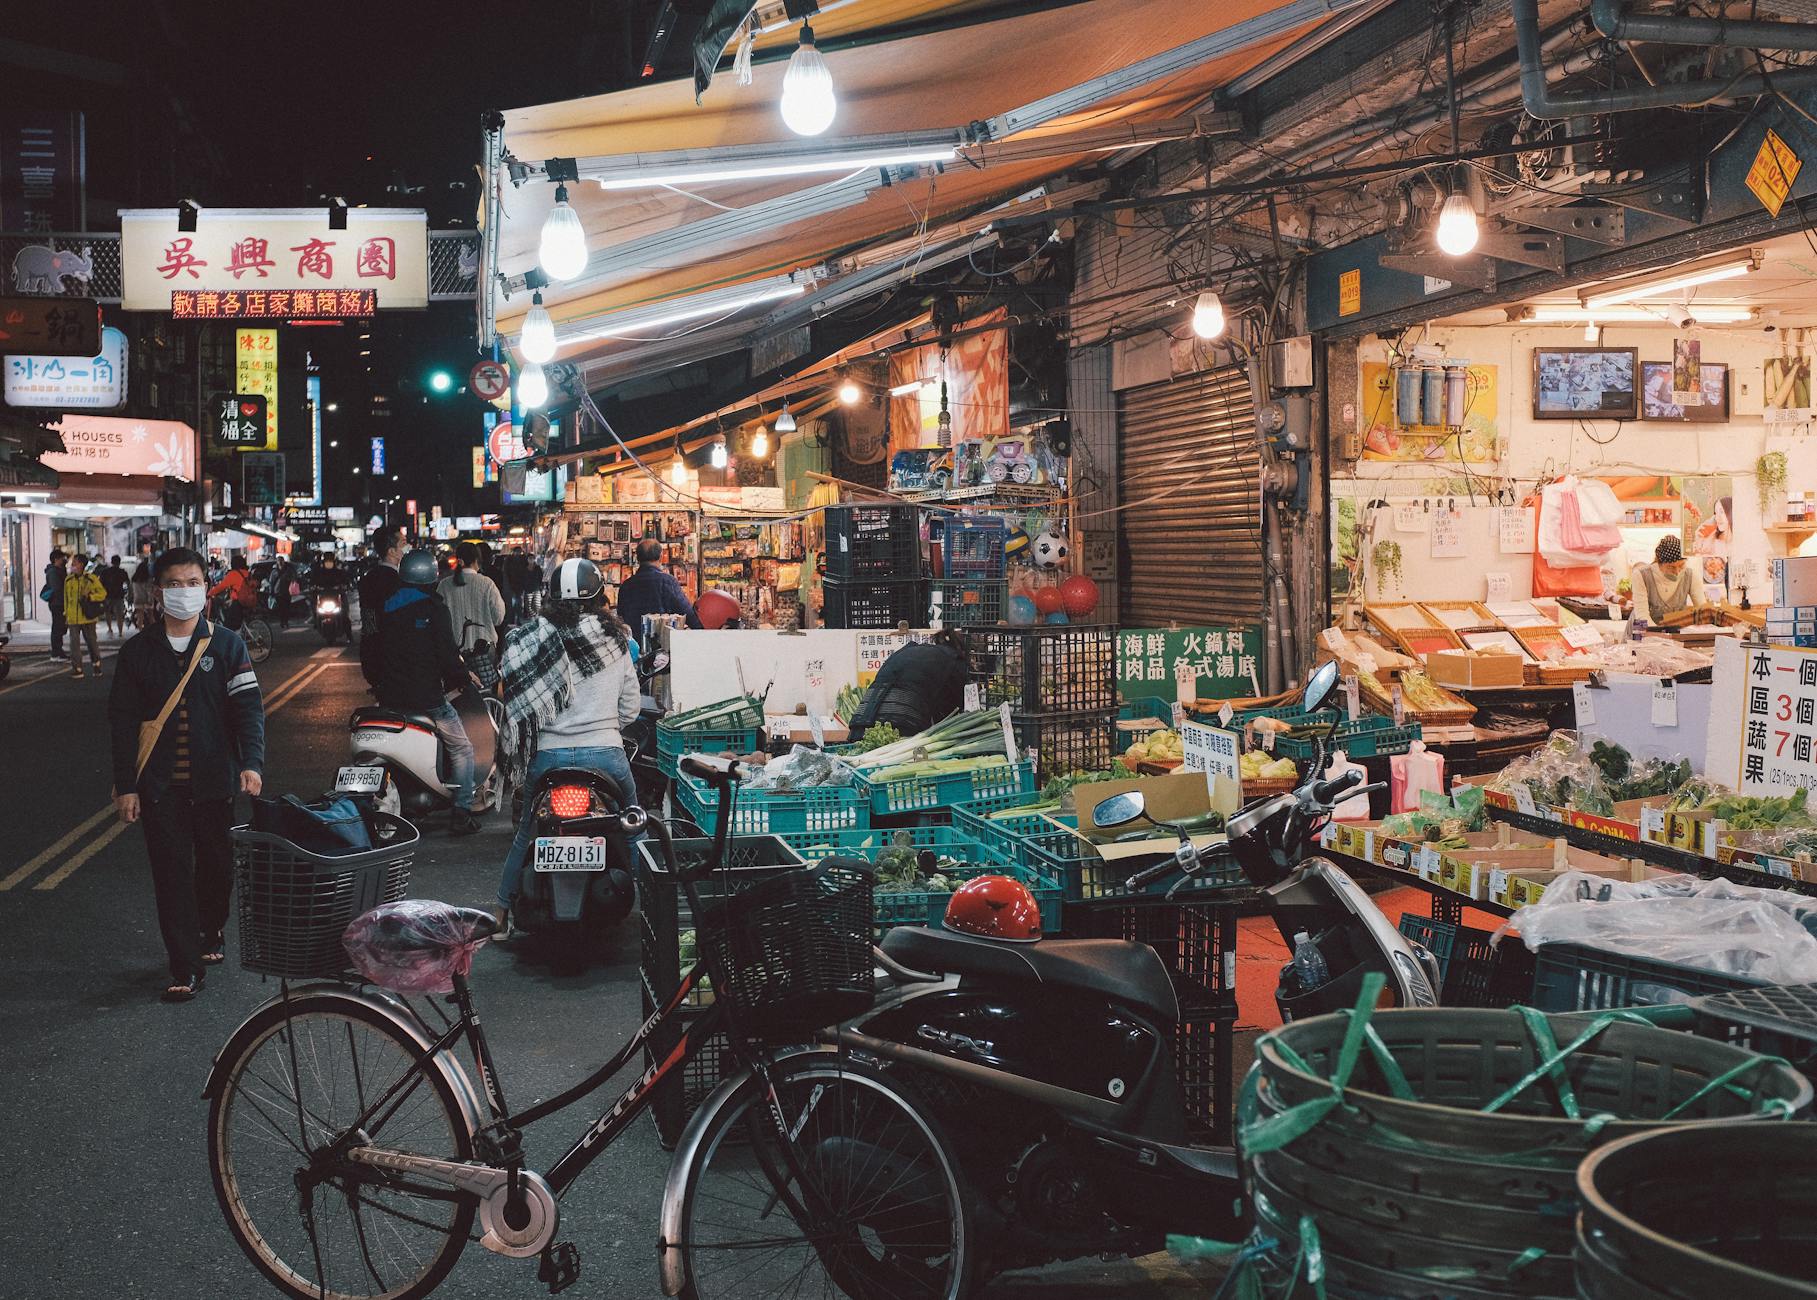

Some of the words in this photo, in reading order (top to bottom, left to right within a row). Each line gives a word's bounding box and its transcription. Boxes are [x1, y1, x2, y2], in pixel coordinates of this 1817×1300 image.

[157, 237, 396, 280] 吳興商圈
[1347, 286, 1359, 297] 019
[240, 335, 273, 351] 陳記
[13, 357, 113, 384] 冰山一角
[72, 431, 123, 443] HOUSES
[221, 421, 258, 441] 福全
[860, 635, 892, 646] 本區商品
[1183, 631, 1245, 656] 火鍋料
[867, 661, 881, 669] 50
[1776, 658, 1817, 687] 一個
[1745, 652, 1771, 784] 本區蔬果
[1774, 694, 1815, 726] 3個
